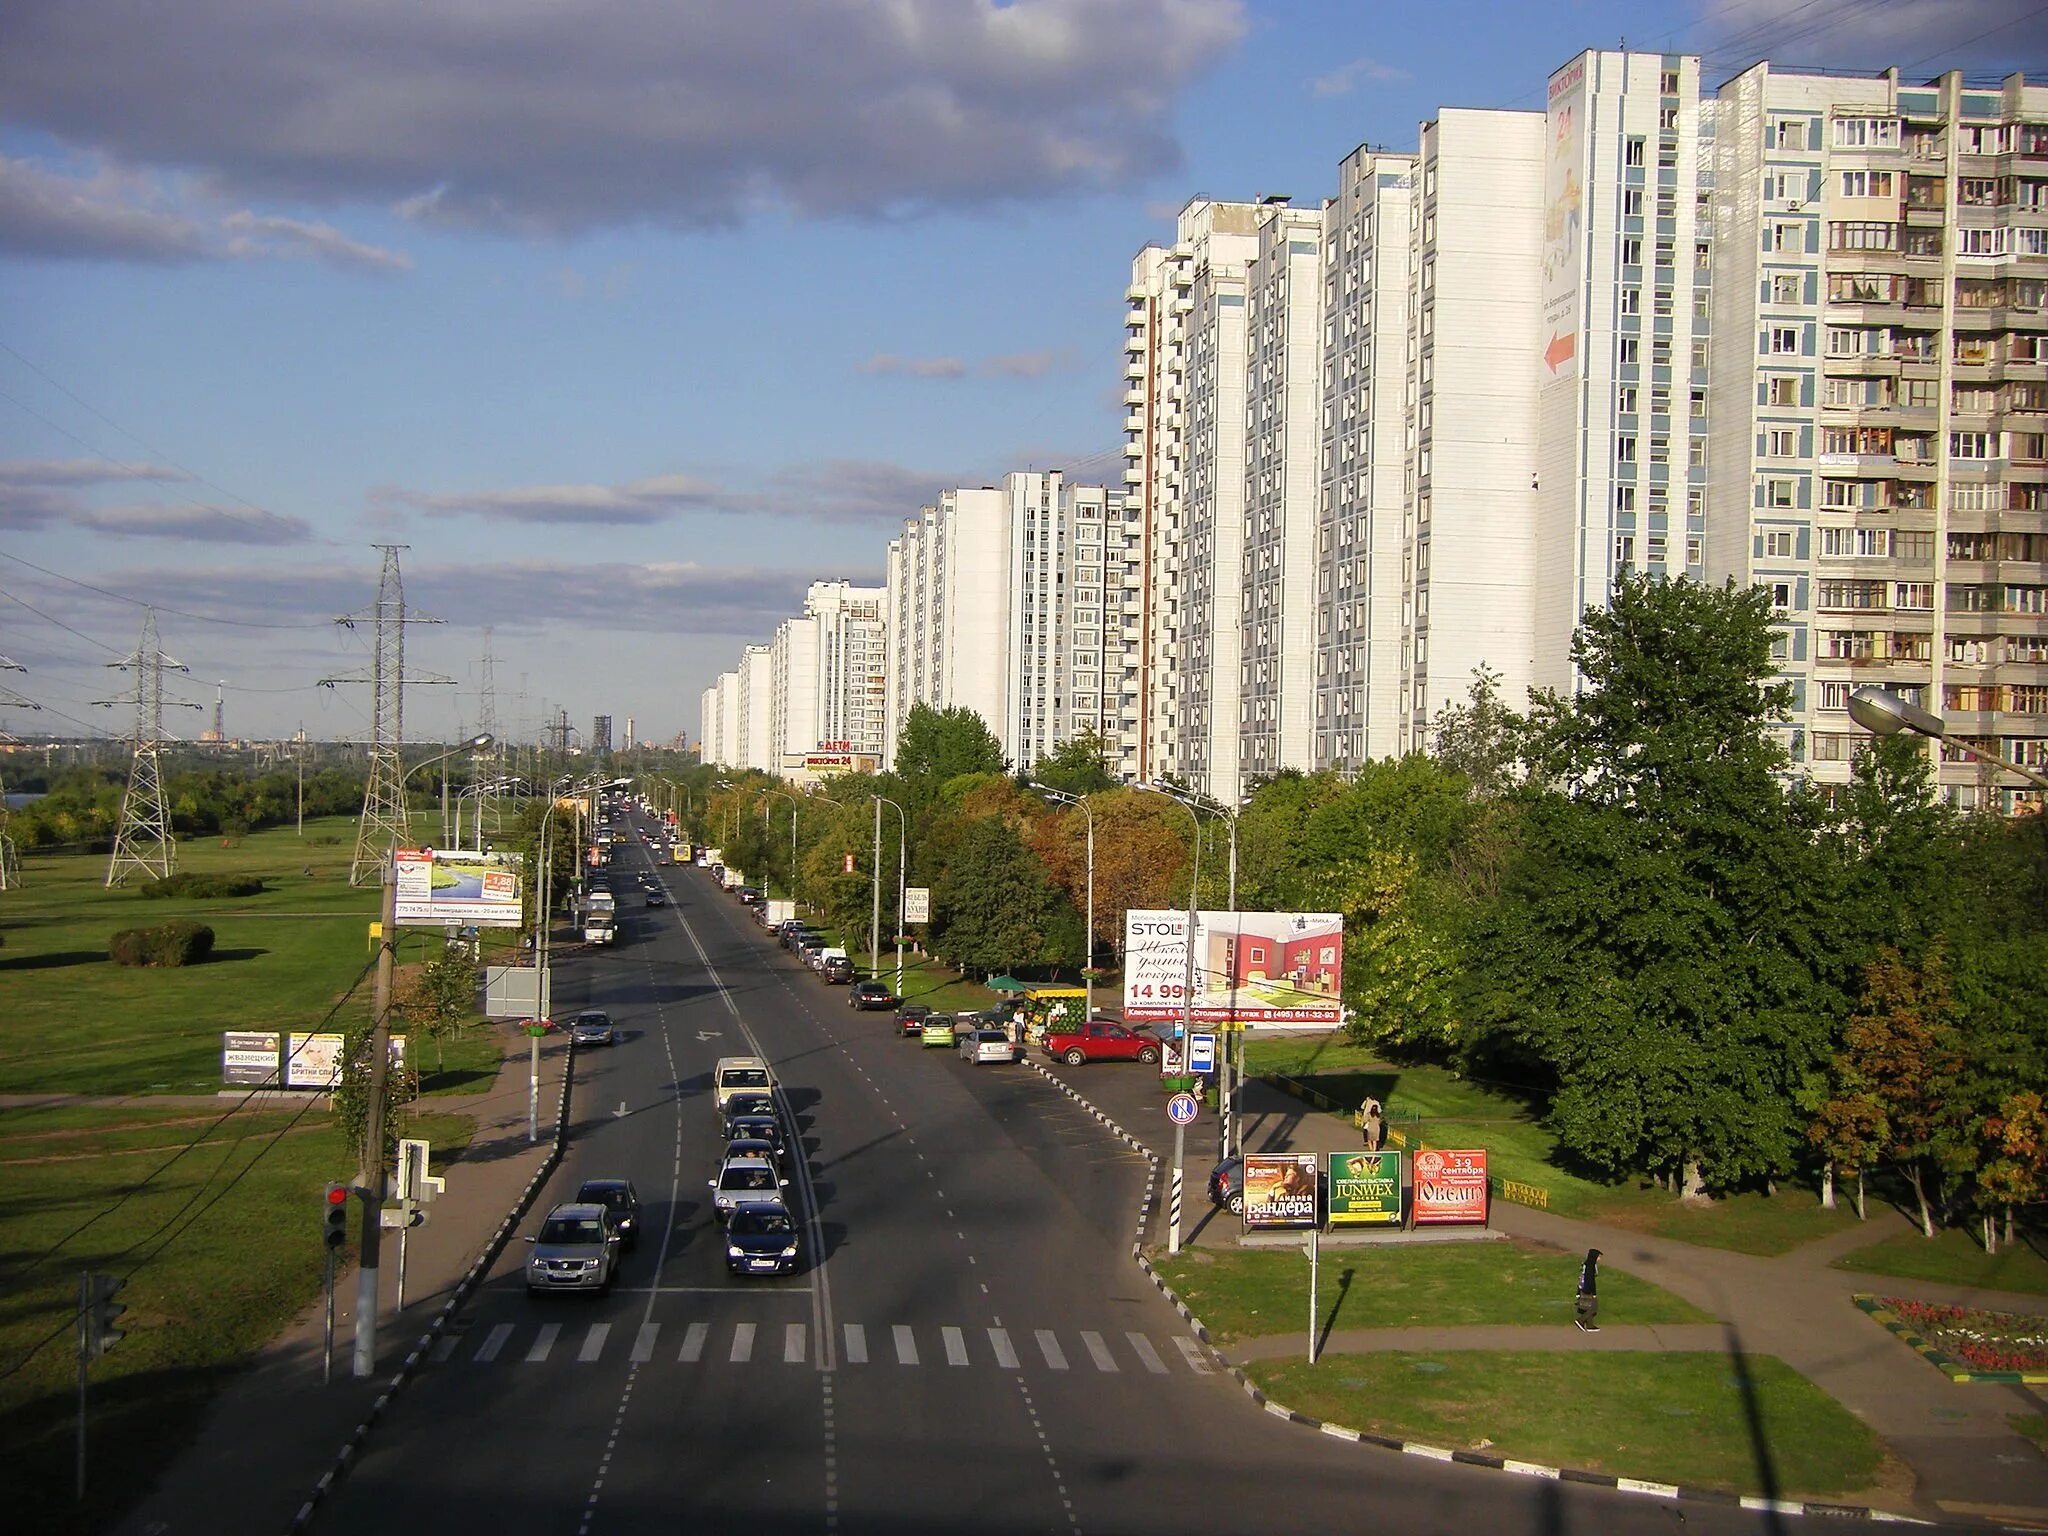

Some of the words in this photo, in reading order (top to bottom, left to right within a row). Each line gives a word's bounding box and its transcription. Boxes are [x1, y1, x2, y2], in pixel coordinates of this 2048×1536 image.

[825, 740, 850, 751] ДЕТИ
[841, 756, 852, 765] 24
[1130, 984, 1154, 998] 14
[1128, 1009, 1167, 1017] Ключевая
[1273, 1010, 1293, 1019] (495)
[1454, 1157, 1473, 1168] 3-9
[1246, 1167, 1256, 1178] 5
[1441, 1166, 1485, 1176] сентября
[1335, 1183, 1394, 1199] JUNWEX
[1279, 1194, 1313, 1202] АНДРЕЙ
[1246, 1201, 1314, 1217] Бандера
